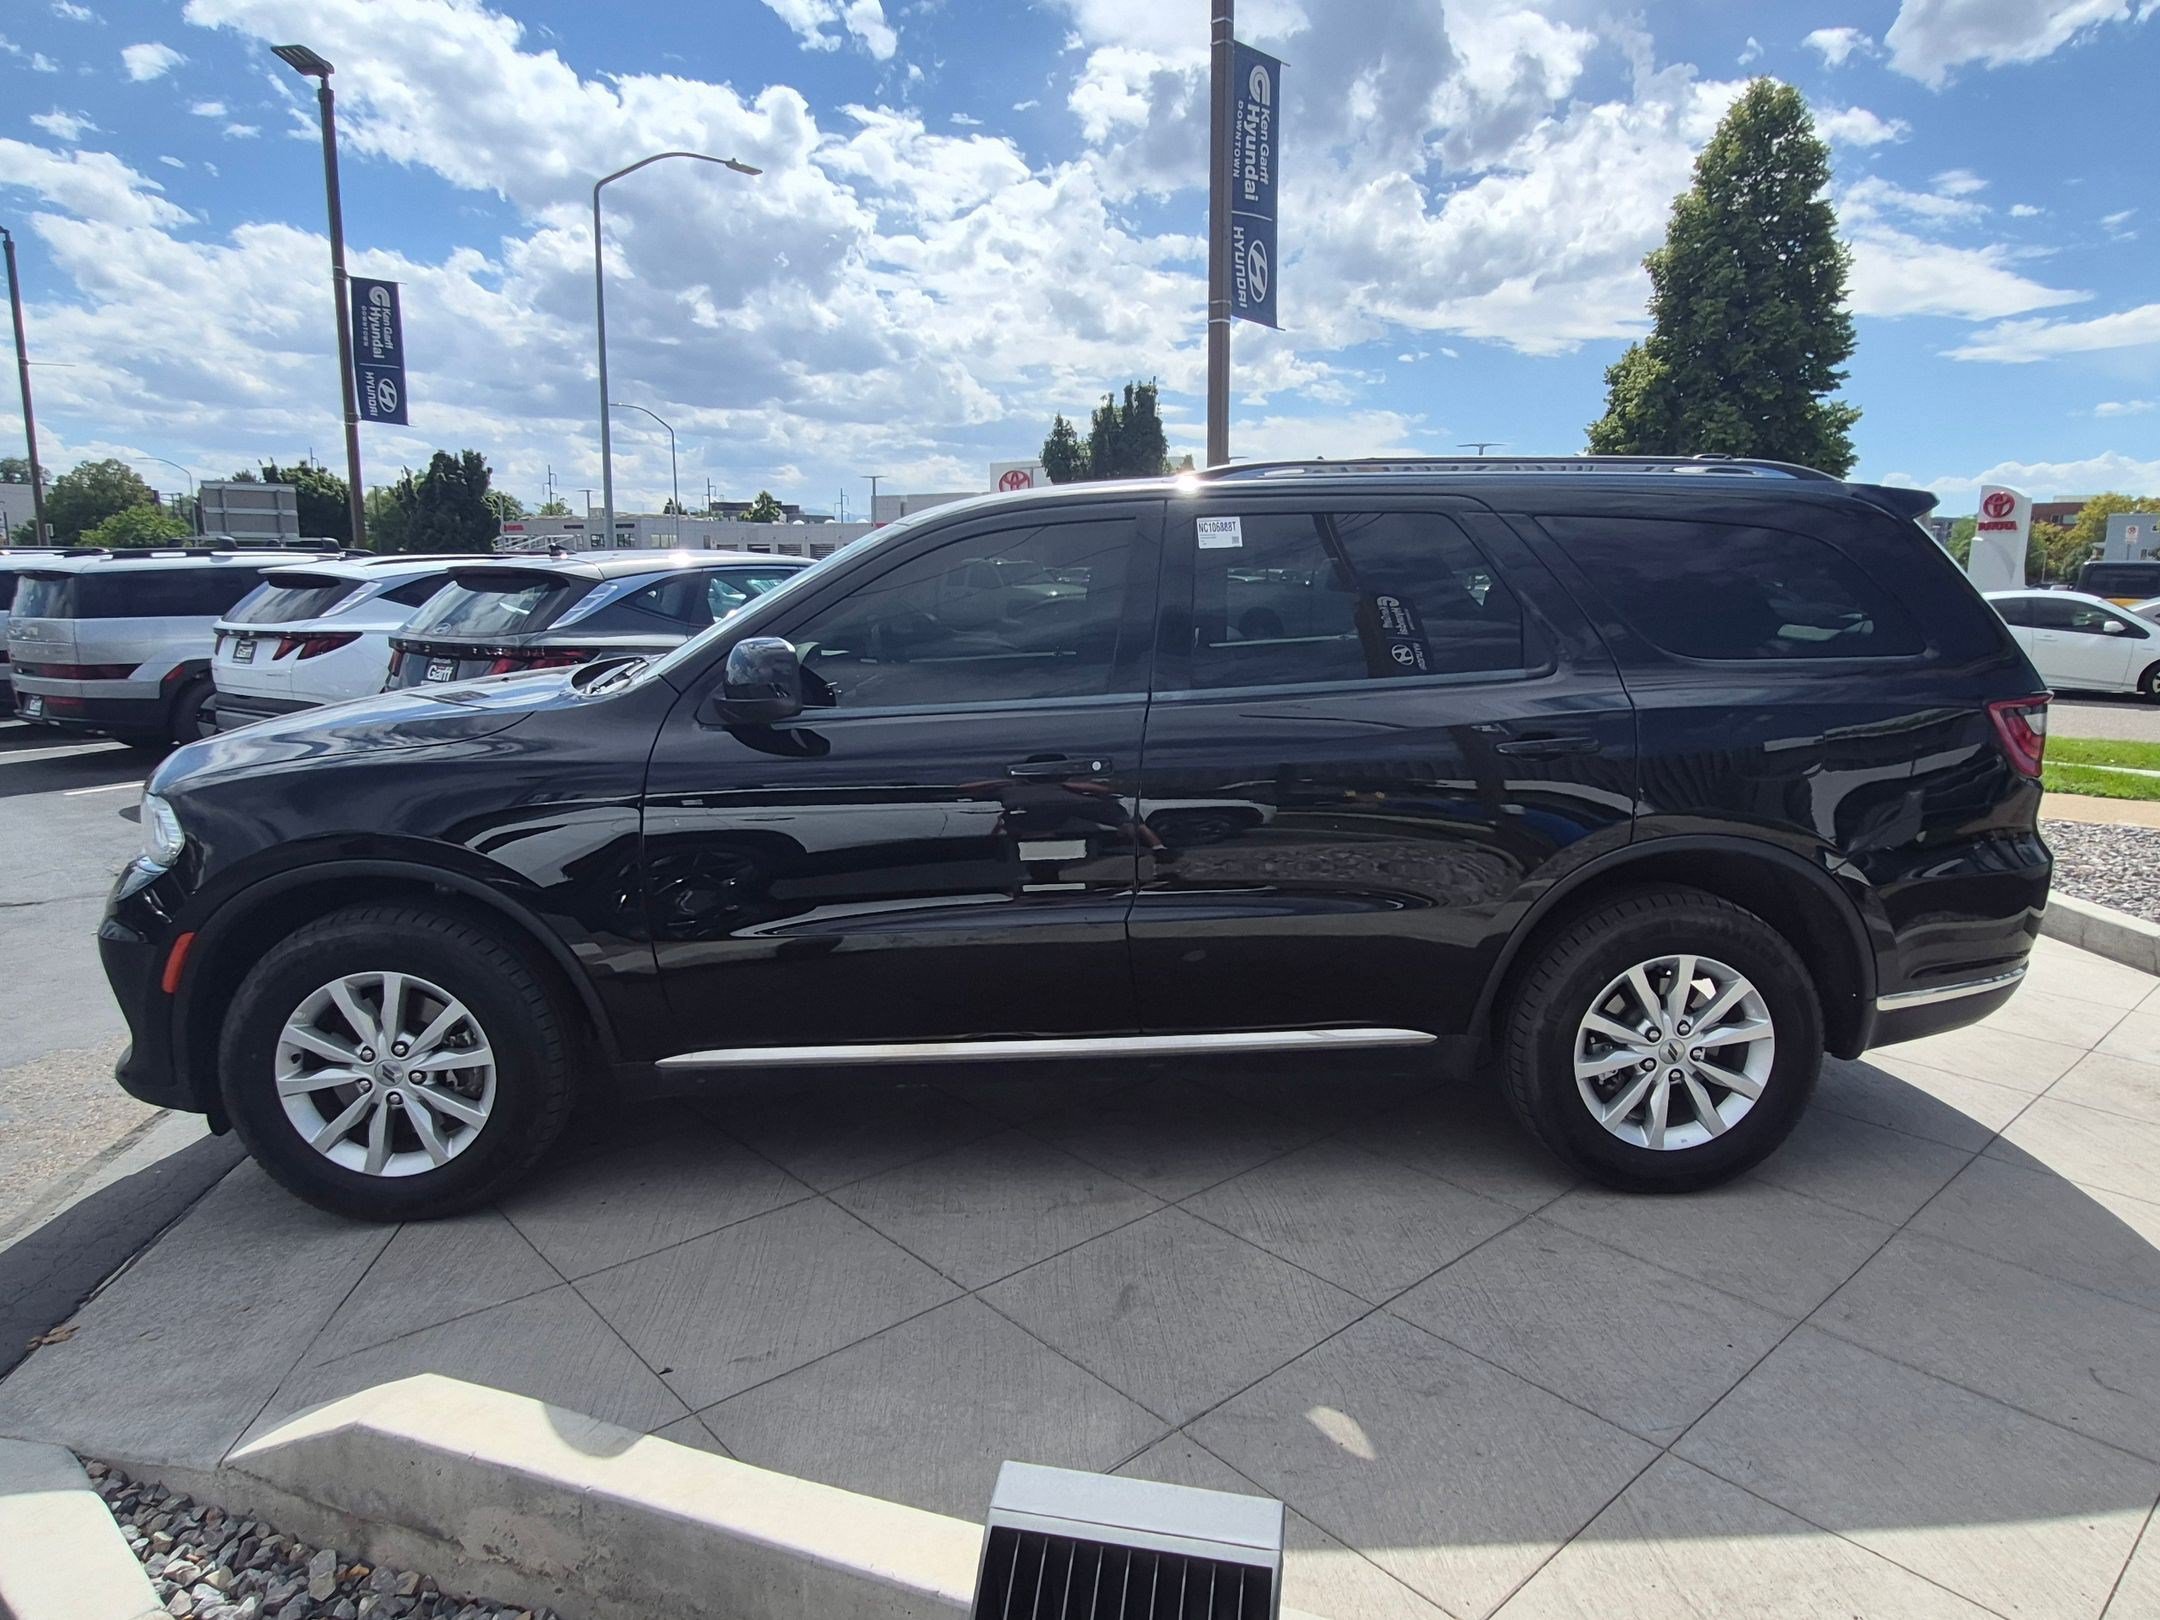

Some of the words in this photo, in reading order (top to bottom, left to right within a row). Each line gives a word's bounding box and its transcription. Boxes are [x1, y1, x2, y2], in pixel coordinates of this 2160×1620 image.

[1233, 100, 1244, 178] DOWNTOWN
[1261, 108, 1271, 140] Ken
[1243, 103, 1260, 202] Hyundai
[1260, 144, 1270, 185] Garff
[1233, 226, 1248, 308] HYUNDAI
[368, 306, 385, 359] Hyundai
[382, 308, 392, 326] Ken
[384, 327, 394, 350] Garff
[365, 371, 378, 417] HYUNDAI
[427, 664, 454, 682] Garff
